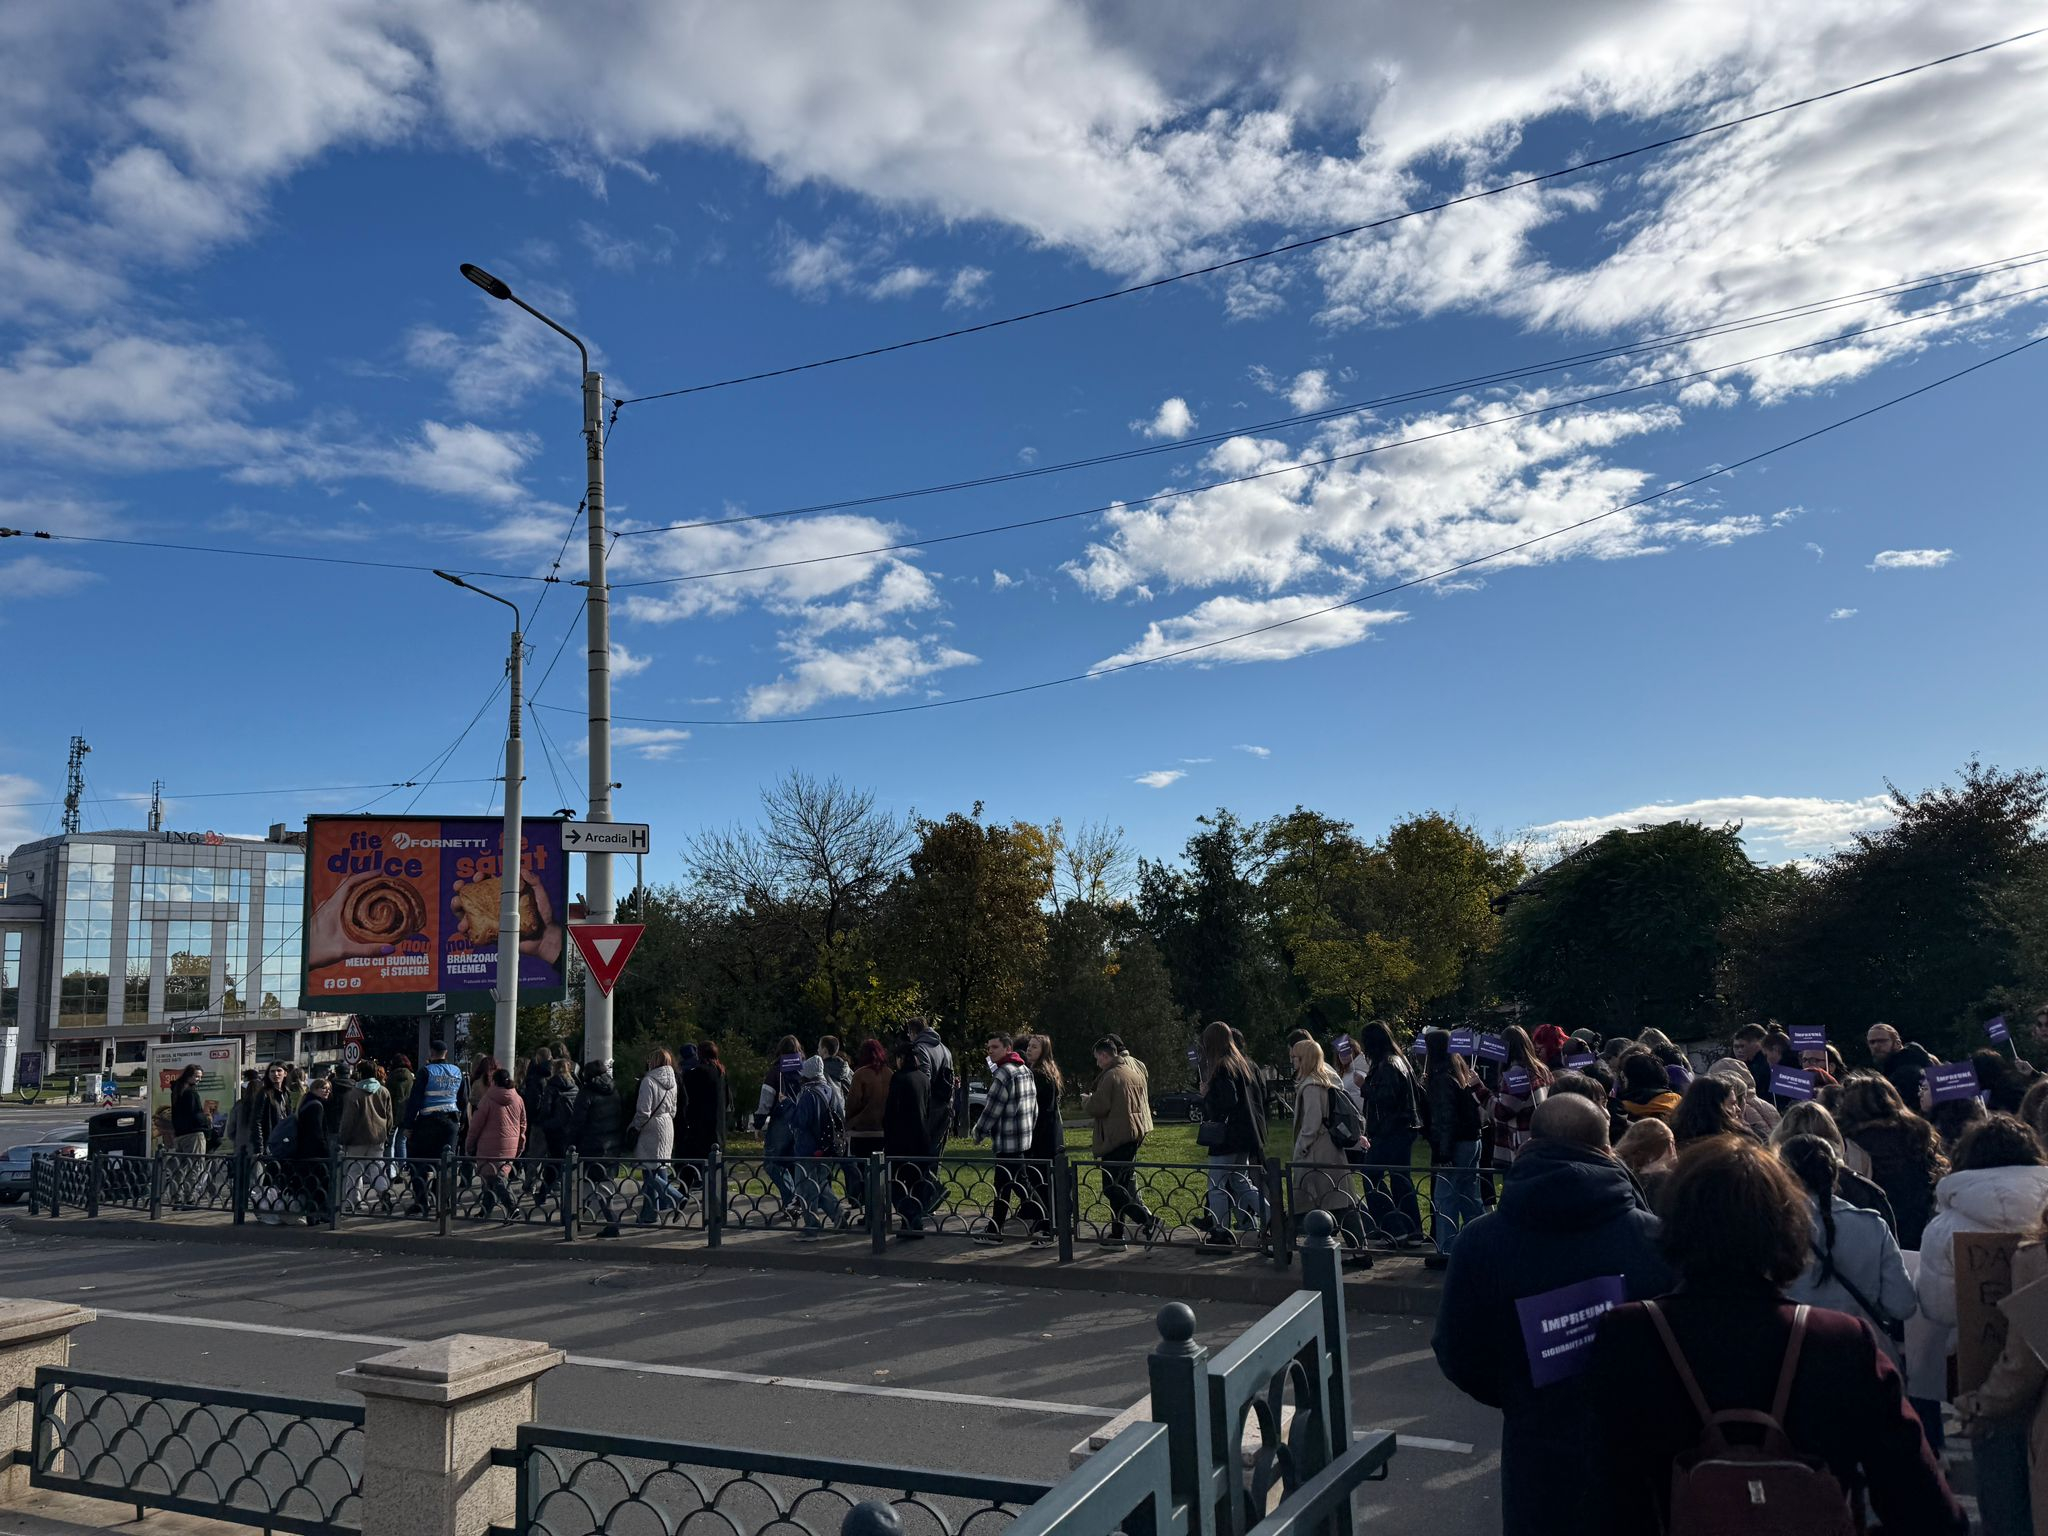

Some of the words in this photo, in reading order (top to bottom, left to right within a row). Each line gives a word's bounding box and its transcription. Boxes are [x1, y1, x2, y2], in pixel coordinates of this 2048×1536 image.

[165, 830, 200, 844] ING
[349, 831, 383, 851] fie
[410, 838, 488, 848] FORNETTI
[584, 832, 628, 844] Arcadia
[327, 847, 423, 878] dulce
[345, 957, 371, 967] MELC
[386, 953, 430, 966] BUDINCĂ
[391, 965, 430, 977] STAFIDE
[446, 963, 487, 975] TELEMEA
[347, 1045, 359, 1059] 30
